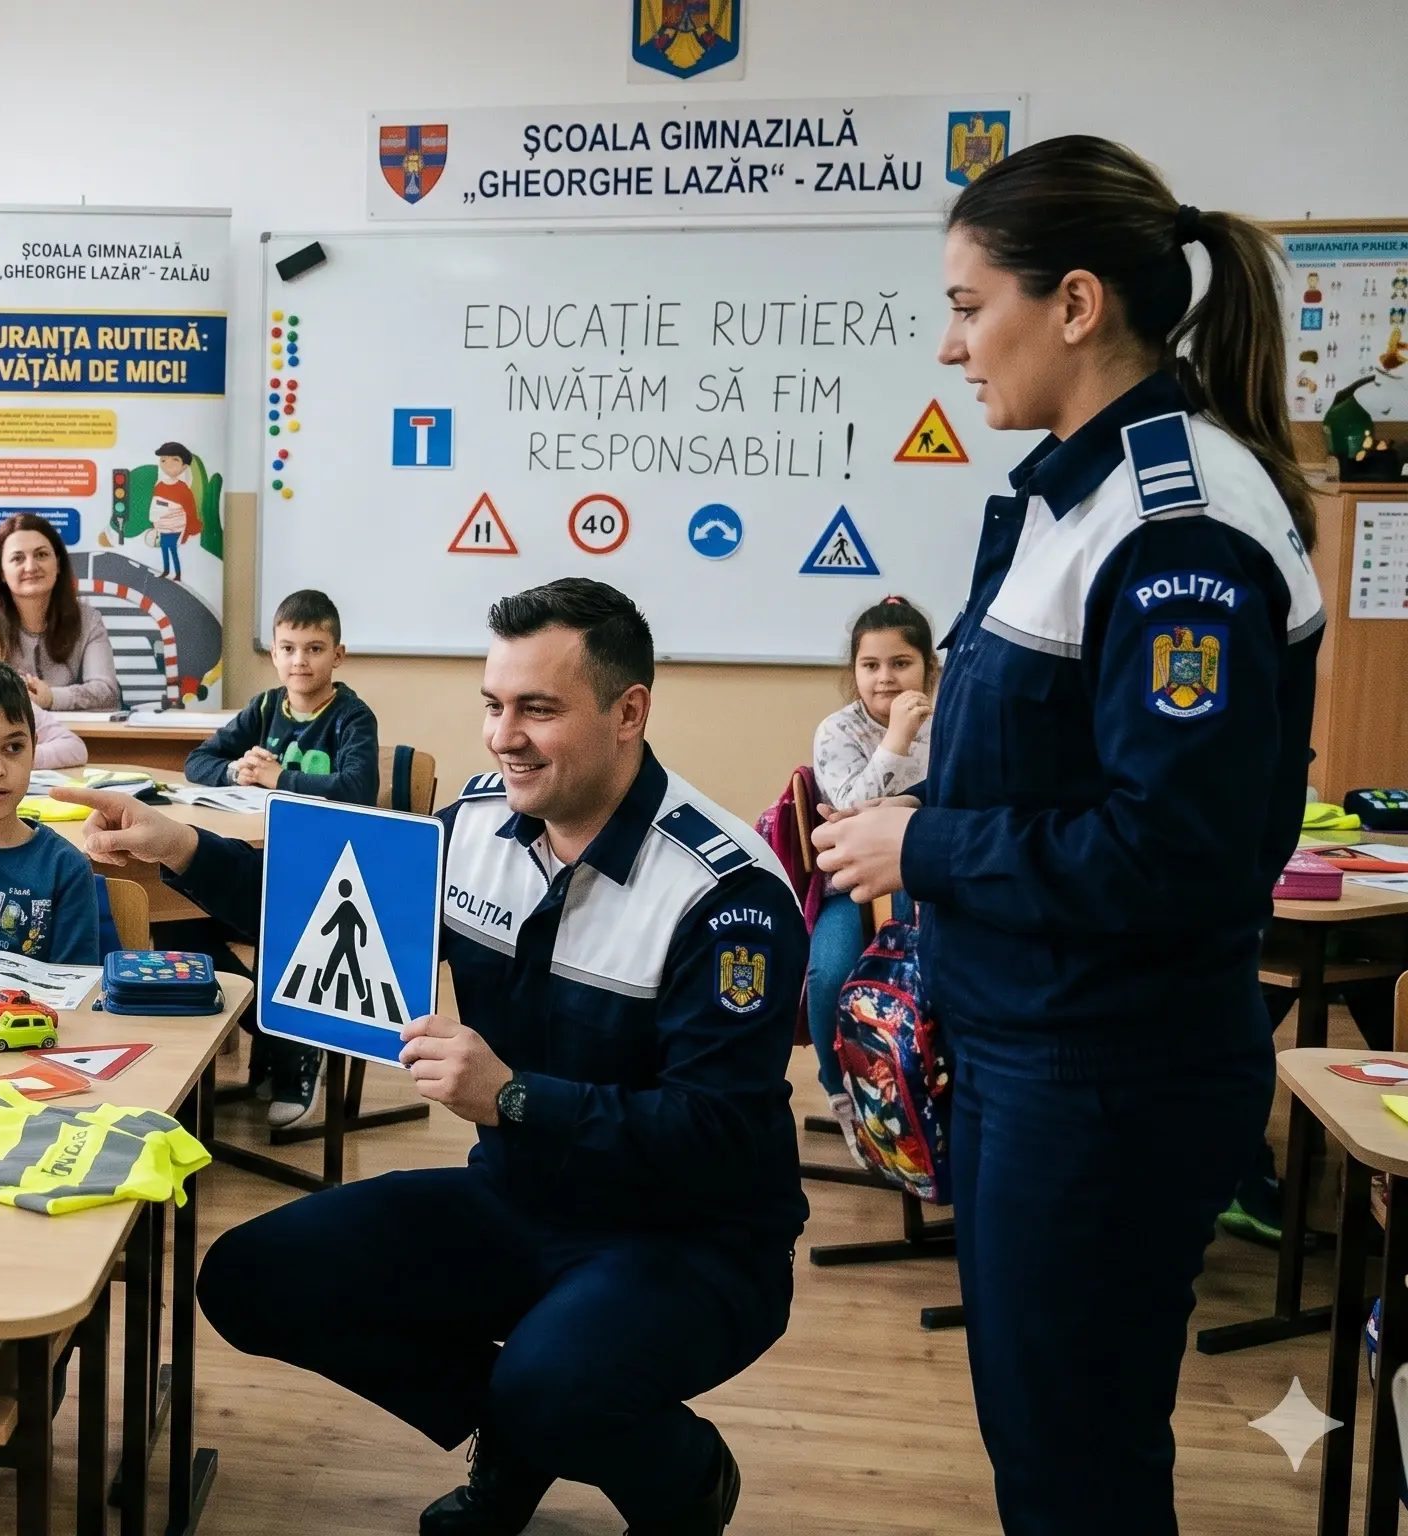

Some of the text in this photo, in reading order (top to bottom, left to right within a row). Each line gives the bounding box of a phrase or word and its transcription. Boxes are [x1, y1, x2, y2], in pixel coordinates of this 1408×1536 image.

[523, 109, 859, 161] ȘCOALA GIMNAZIALĂ
[814, 154, 923, 192] ZALĂU
[22, 241, 183, 261] ȘCOALA GIMNAZIALĂ
[160, 264, 210, 282] ZALĂU
[97, 322, 209, 352] RUTIERĂ:
[464, 294, 681, 356] EDUCAȚIE
[88, 359, 120, 383] DE
[125, 359, 187, 384] MICI!
[504, 362, 842, 421] ÎNVĂȚĂM SĂ FIM
[582, 515, 616, 535] 40
[1135, 574, 1236, 608] POLIȚIA
[446, 884, 513, 931] POLIȚIA
